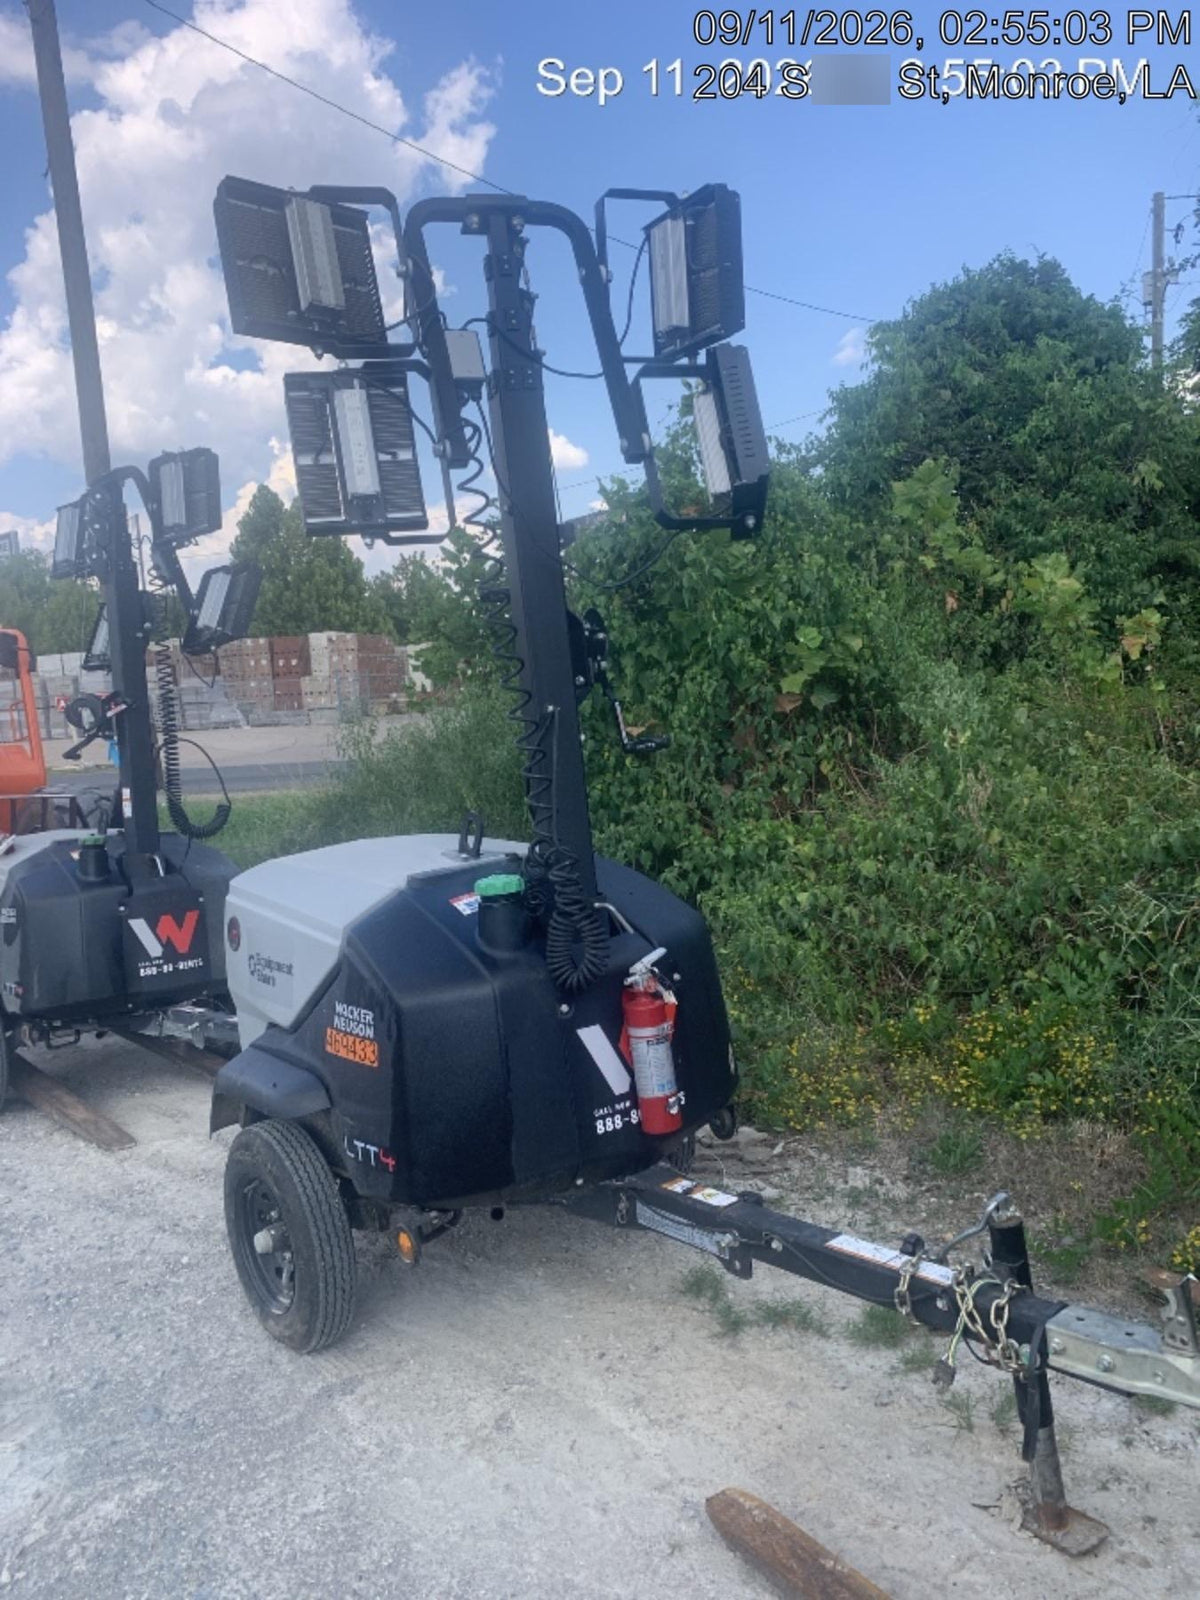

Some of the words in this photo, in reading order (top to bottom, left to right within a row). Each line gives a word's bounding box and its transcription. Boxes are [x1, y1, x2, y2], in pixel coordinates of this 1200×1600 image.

[335, 1000, 374, 1025] WACKER
[333, 1015, 374, 1039] NEUSON
[595, 1109, 642, 1135] 888-8
[344, 1135, 396, 1173] LTT4
